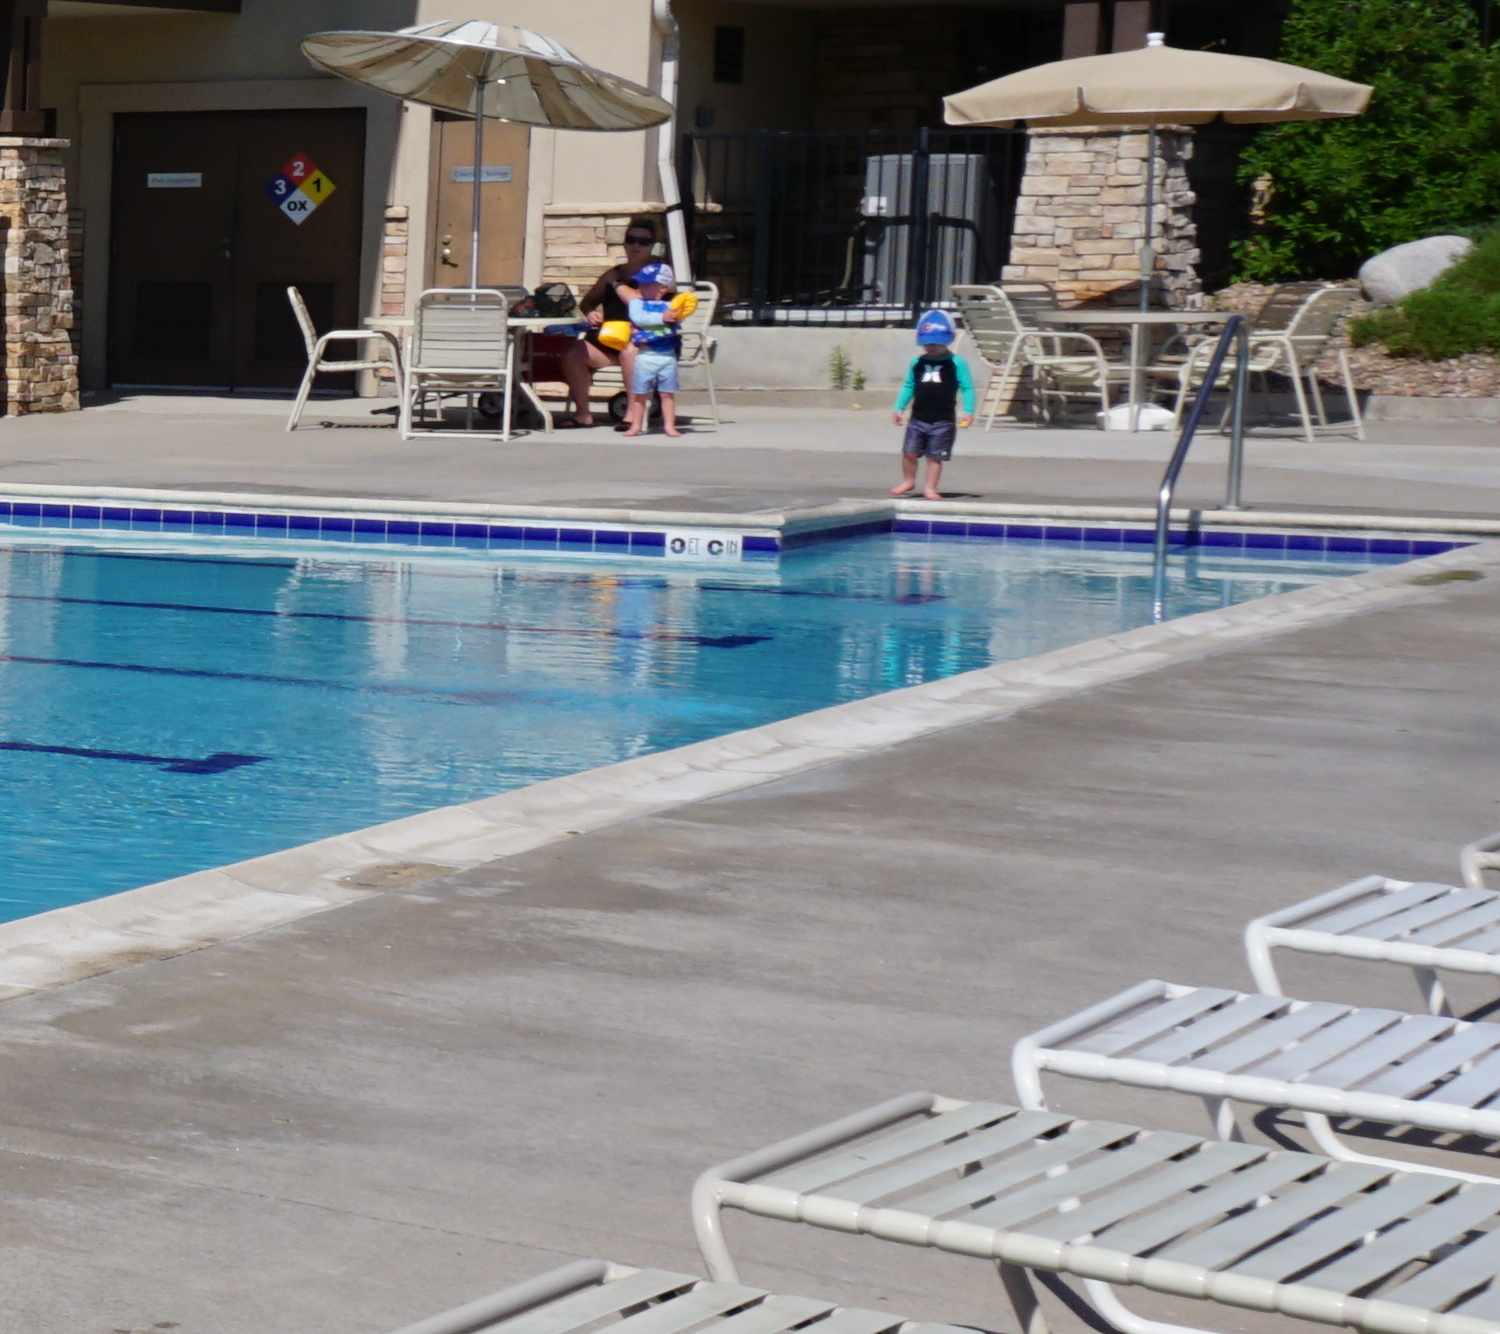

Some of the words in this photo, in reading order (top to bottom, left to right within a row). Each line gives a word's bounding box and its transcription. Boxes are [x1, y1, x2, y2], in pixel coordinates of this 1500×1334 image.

[292, 161, 304, 176] 2
[274, 179, 287, 194] 3
[312, 178, 321, 192] 1
[287, 200, 308, 212] OX
